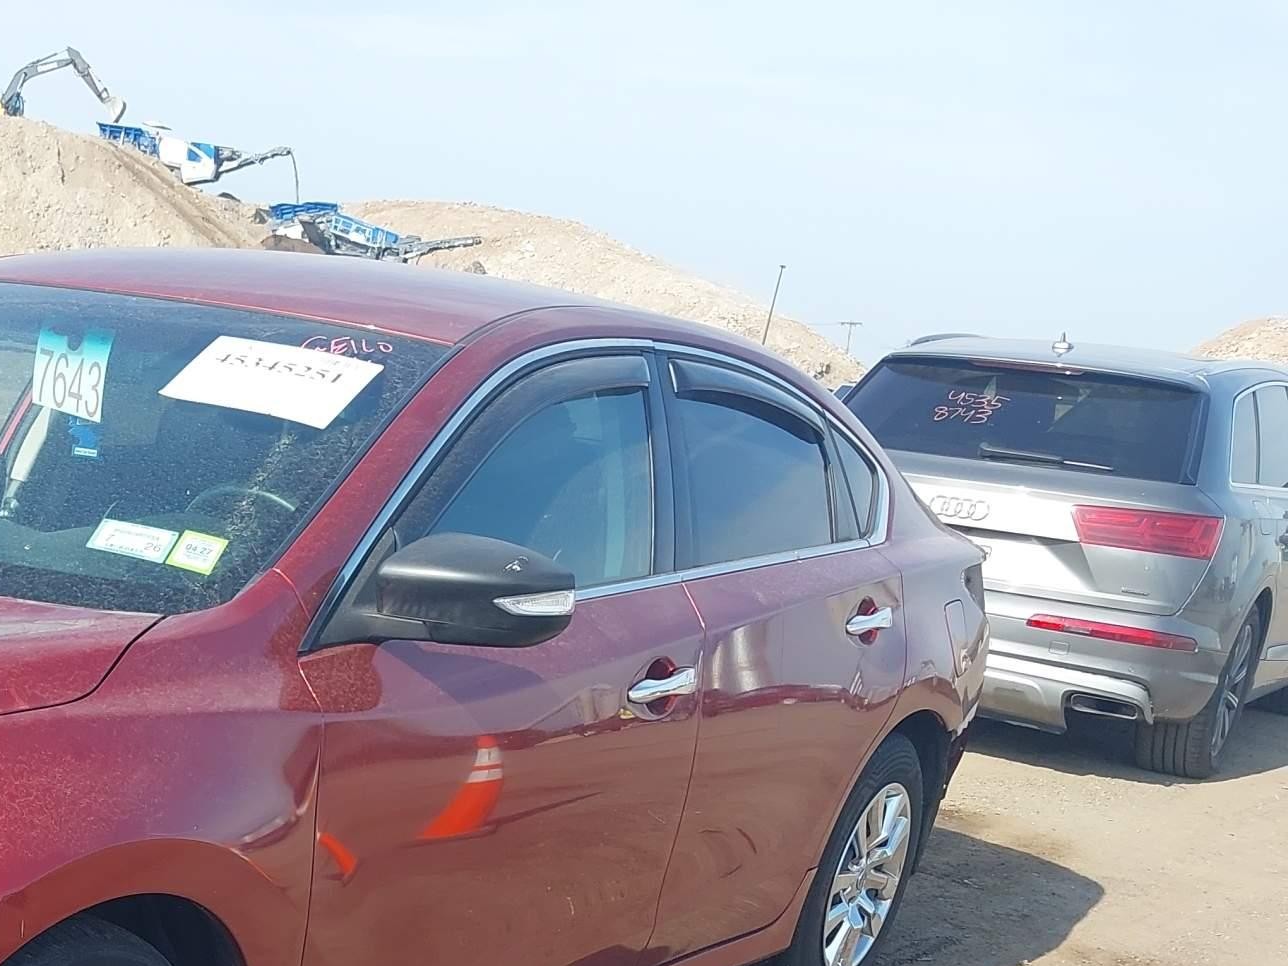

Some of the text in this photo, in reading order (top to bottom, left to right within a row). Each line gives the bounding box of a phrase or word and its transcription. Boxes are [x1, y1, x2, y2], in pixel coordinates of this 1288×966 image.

[39, 347, 102, 418] 7643
[948, 390, 1011, 410] 4535
[934, 406, 993, 424] 8743
